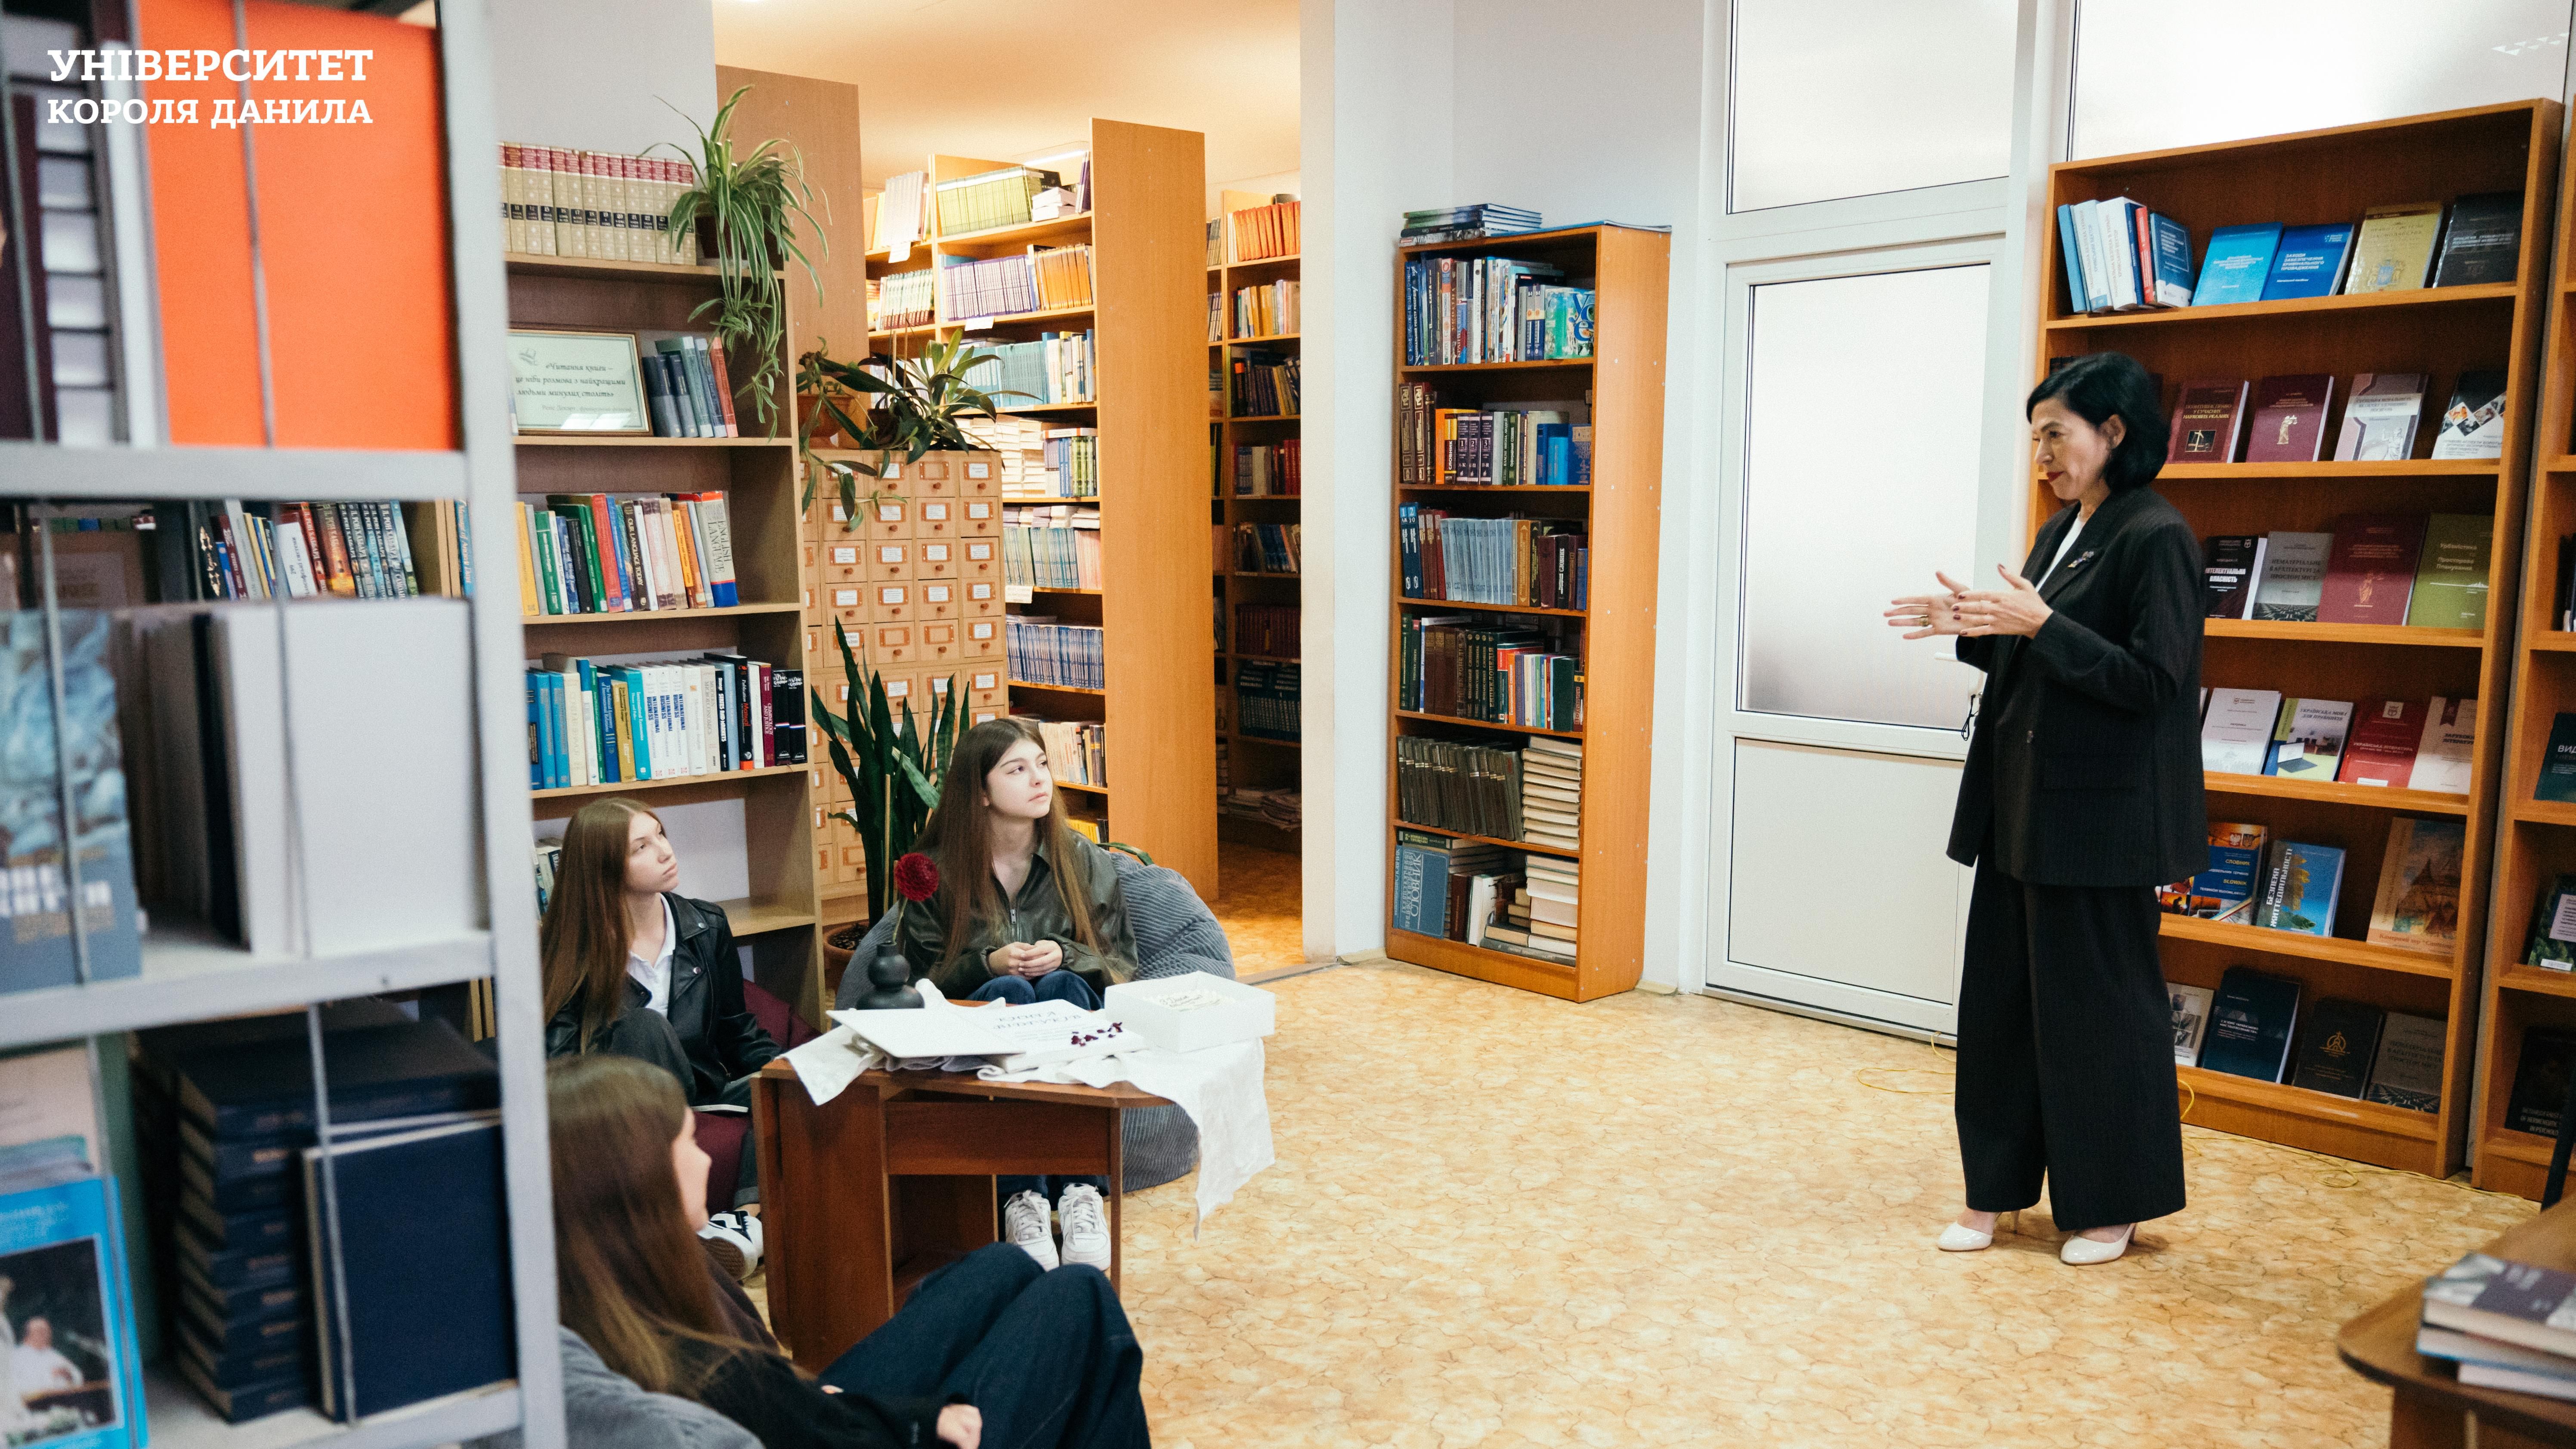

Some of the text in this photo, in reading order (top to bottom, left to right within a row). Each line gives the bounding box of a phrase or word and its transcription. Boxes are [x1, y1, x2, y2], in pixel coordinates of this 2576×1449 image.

[580, 378, 626, 386] найкращими
[352, 517, 361, 529] РОН
[383, 517, 393, 530] РОН
[628, 518, 636, 533] OUR
[1402, 508, 1405, 517] 1
[1409, 507, 1414, 516] 2
[309, 530, 321, 559] ХАББАРД
[354, 529, 366, 558] ХАББАРД
[376, 529, 386, 558] ХАББАРД
[387, 530, 398, 559] ХАББАРД
[630, 533, 640, 567] LANGUAGE
[708, 522, 725, 574] LANGUAGE
[717, 521, 732, 562] ENGLISH
[1410, 854, 1421, 917] СЛОВНИК
[2266, 868, 2280, 905] БЕЗПЕКА
[2270, 848, 2293, 927] ЖИТТЄДІЯЛЬНОСТІ
